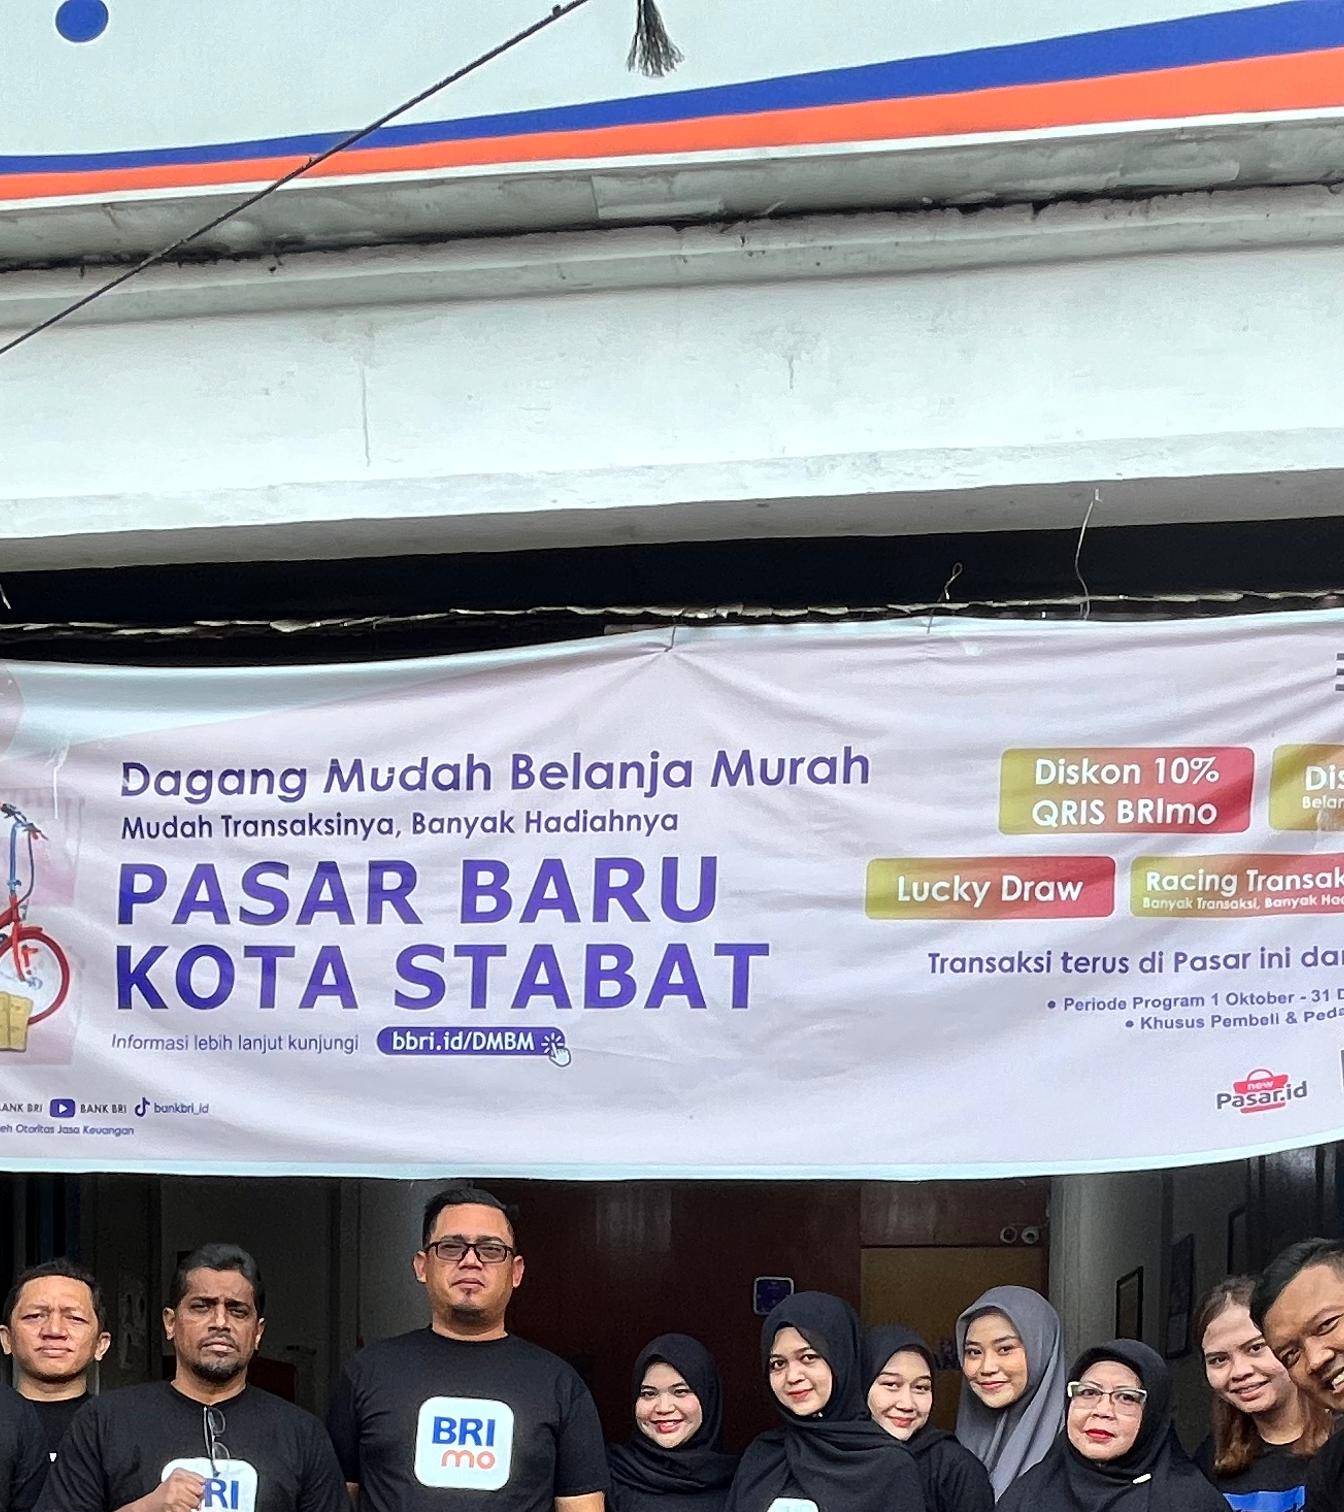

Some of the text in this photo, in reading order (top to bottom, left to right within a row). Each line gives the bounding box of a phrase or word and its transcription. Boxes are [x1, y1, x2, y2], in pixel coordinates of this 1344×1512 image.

[121, 745, 872, 804] Dagang Mudah Belanja Murah
[1034, 756, 1221, 786] Diskon 10%
[120, 808, 679, 842] Mudah Transaksinya, Banyak Hadiahnya
[1031, 799, 1218, 829] QRIS BRImo
[116, 855, 719, 926] PASAR BARU
[897, 874, 1084, 908] Lucky Draw
[1145, 868, 1238, 898] Racing
[1142, 896, 1194, 913] Banyak
[1264, 893, 1319, 910] Banyak
[927, 949, 1054, 975] Transaksi
[1059, 950, 1131, 975] terus
[1138, 947, 1165, 974] di
[1172, 946, 1253, 973] Pasar
[1258, 943, 1292, 971] ini
[116, 943, 770, 1010] KOTA STABAT
[1062, 995, 1127, 1013] Periode
[1131, 993, 1206, 1014] Program
[1210, 991, 1220, 1009] 1
[1225, 988, 1296, 1009] Oktober
[1311, 986, 1332, 1004] 31
[1140, 1012, 1206, 1031] Khusus
[1285, 1008, 1299, 1024] &
[111, 1032, 359, 1057] Informasi lebih lanjut kunjungi
[391, 1029, 535, 1056] bbri.id/DMBM
[1215, 1081, 1309, 1111] Pasar.id
[1246, 1079, 1274, 1092] new
[27, 1103, 44, 1113] BRI
[80, 1104, 127, 1114] BANK BRI
[15, 1124, 55, 1135] Otoritas
[57, 1125, 81, 1135] Jasa
[82, 1125, 135, 1138] Keuangan
[431, 1415, 496, 1447] BRI
[441, 1450, 495, 1470] mo
[203, 1478, 239, 1510] RI
